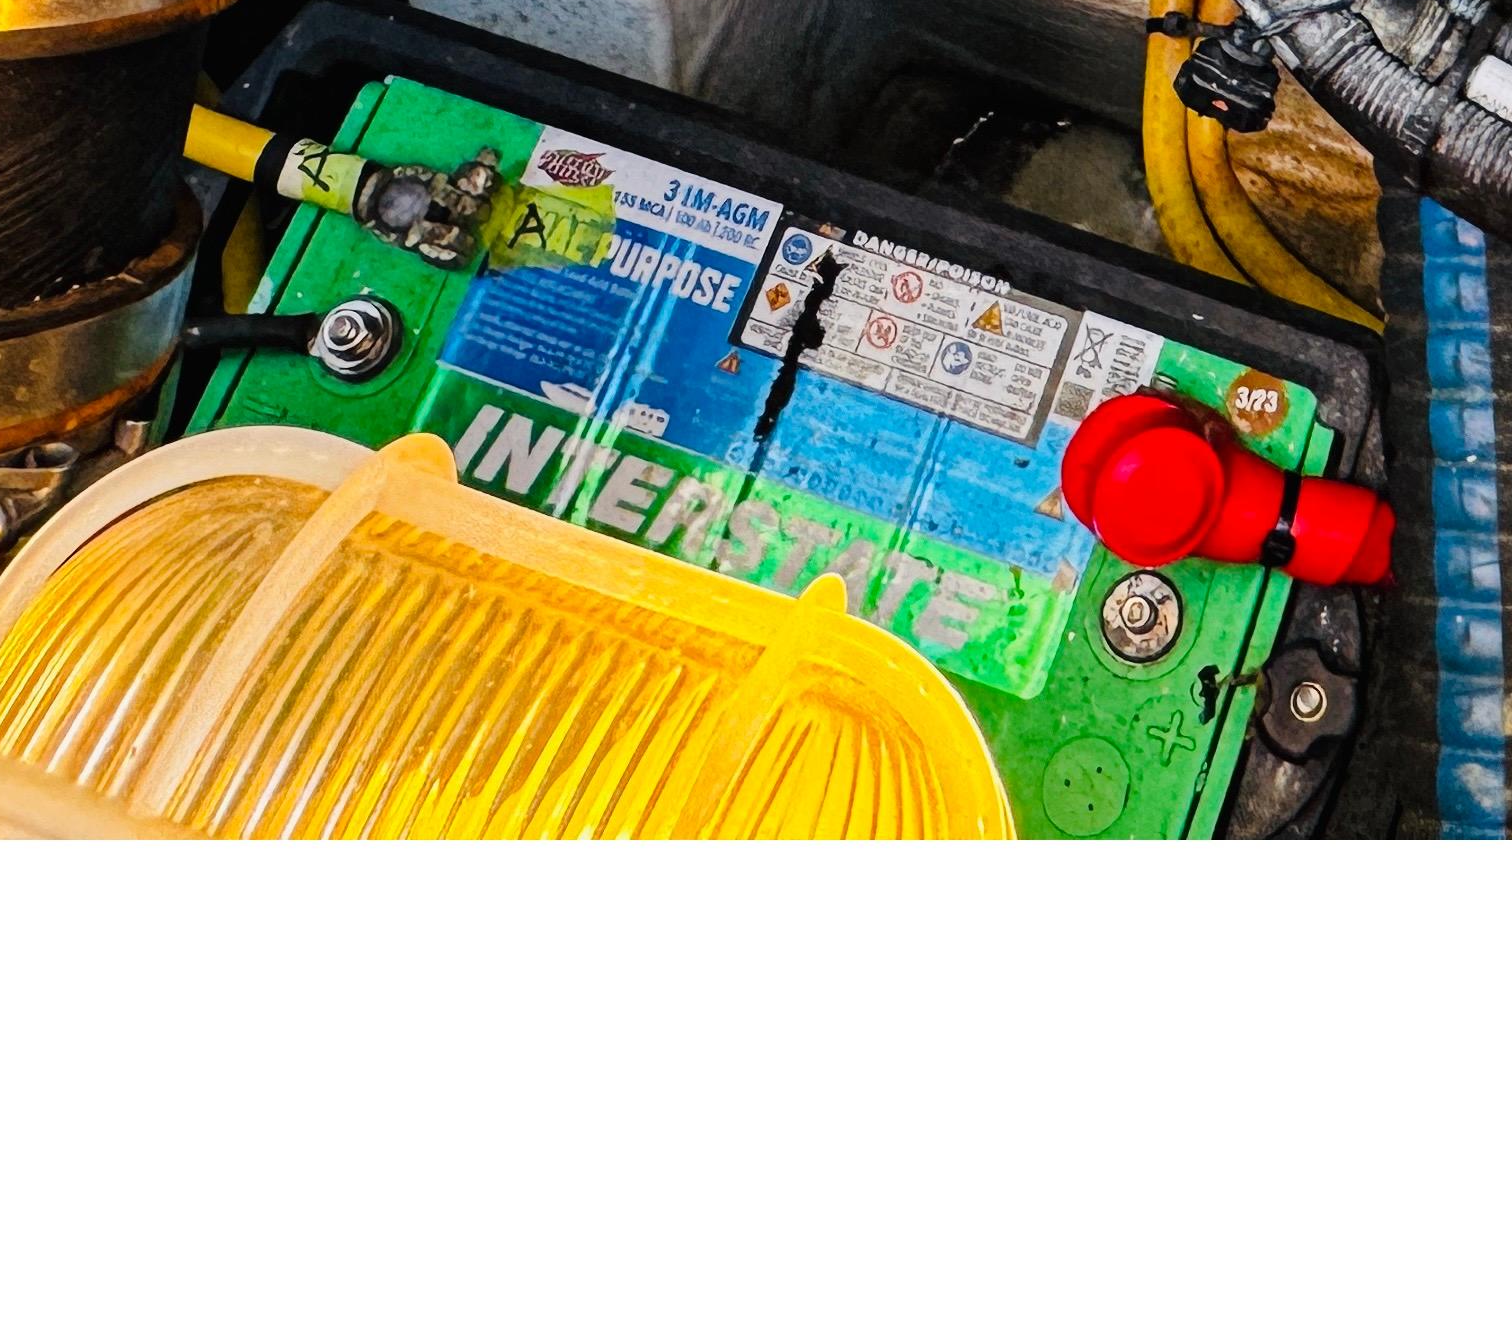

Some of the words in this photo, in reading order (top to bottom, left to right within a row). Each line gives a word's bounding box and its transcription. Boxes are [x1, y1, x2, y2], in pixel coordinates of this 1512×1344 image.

[507, 202, 547, 250] A
[589, 231, 743, 314] PURPOSE
[454, 403, 998, 651] INTERSTATE
